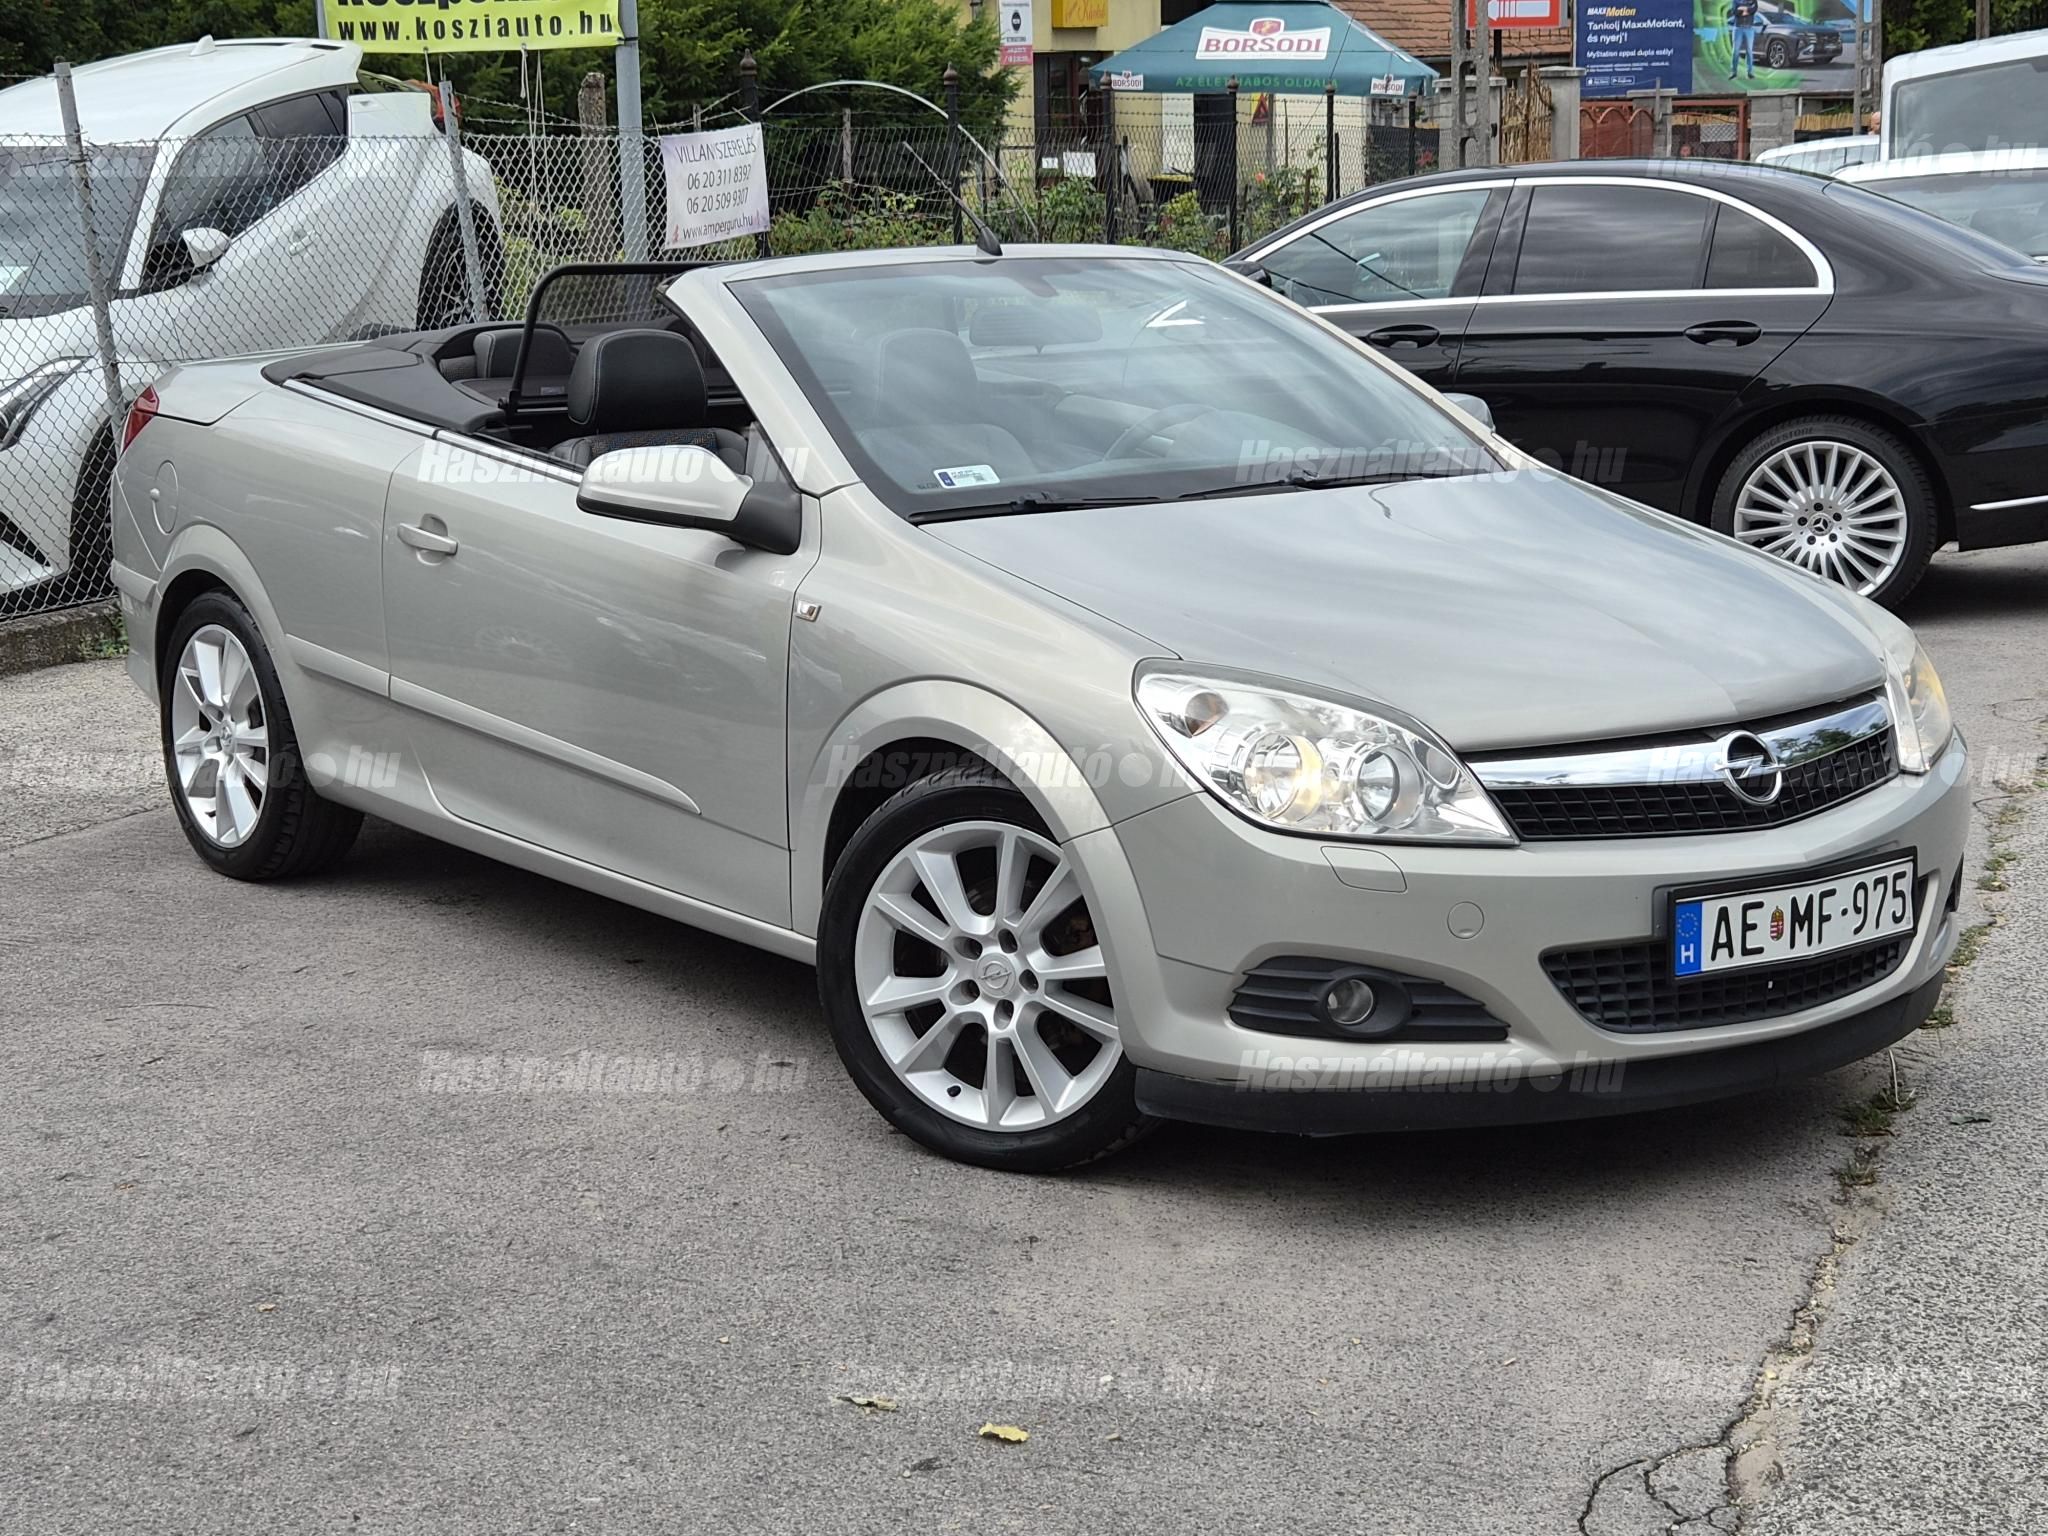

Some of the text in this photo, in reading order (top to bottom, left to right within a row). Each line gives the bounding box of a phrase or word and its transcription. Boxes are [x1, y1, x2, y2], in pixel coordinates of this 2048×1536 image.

[337, 11, 613, 41] www.kosziauto.hu
[1587, 21, 1620, 31] Tankolj
[1204, 38, 1322, 52] BORSODI
[1586, 32, 1598, 43] és
[1175, 77, 1193, 87] AZ
[687, 172, 700, 190] 06
[702, 170, 715, 188] 20
[716, 167, 732, 186] 311
[686, 196, 699, 214] 06
[701, 194, 714, 212] 20
[715, 192, 732, 210] 509
[1710, 870, 1908, 961] AE MF-975
[1680, 943, 1695, 964] H
